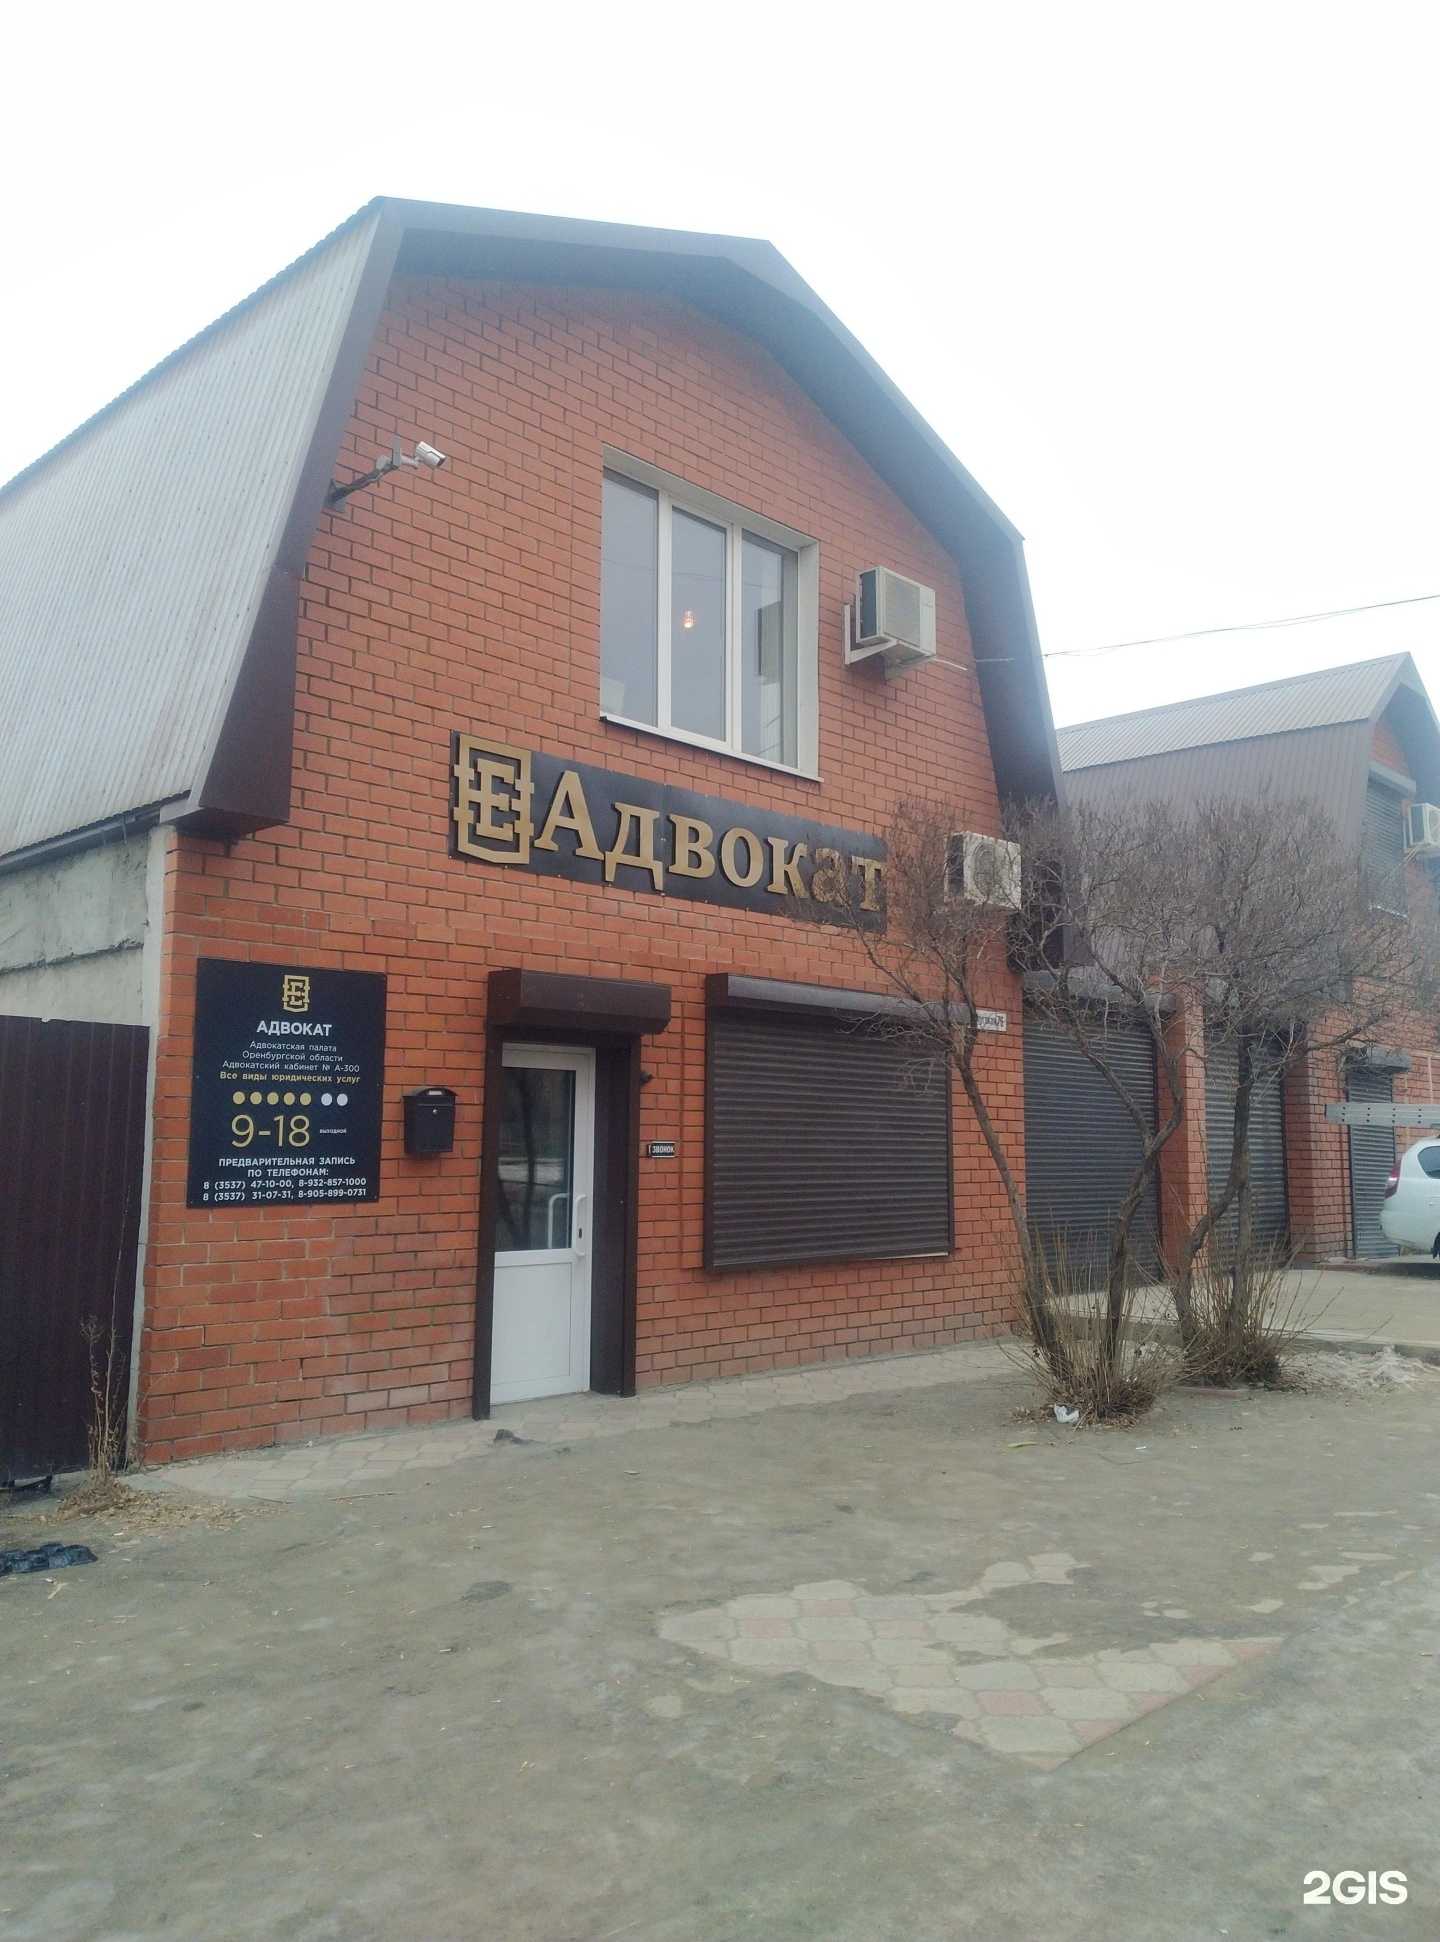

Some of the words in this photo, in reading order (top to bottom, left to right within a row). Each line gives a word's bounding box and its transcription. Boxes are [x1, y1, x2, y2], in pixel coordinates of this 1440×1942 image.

[256, 1020, 333, 1037] АДВОКАТ
[249, 1040, 305, 1051] Адвокатская
[308, 1043, 337, 1053] палата
[242, 1050, 306, 1062] Оренбургской
[309, 1052, 343, 1062] области
[222, 1060, 280, 1070] Адвокатский
[284, 1062, 318, 1071] кабинет
[334, 1063, 361, 1073] А-300
[219, 1071, 238, 1080] Все
[242, 1073, 267, 1081] виды
[271, 1073, 333, 1083] юридических
[336, 1076, 361, 1084] услуг
[231, 1114, 310, 1148] 9-18
[218, 1157, 315, 1167] ПРЕДВАРИТЕЛЬНАЯ
[319, 1156, 356, 1166] ЗАПИСЬ
[247, 1169, 262, 1178] ПО
[267, 1168, 329, 1178] ТЕЛЕФОНАМ:
[203, 1181, 210, 1190] 8
[214, 1180, 246, 1191] (3537)
[250, 1180, 294, 1190] 47-10-00,
[202, 1193, 209, 1201] 8
[214, 1192, 245, 1202] (3537)
[251, 1190, 294, 1200] 31-07-31,
